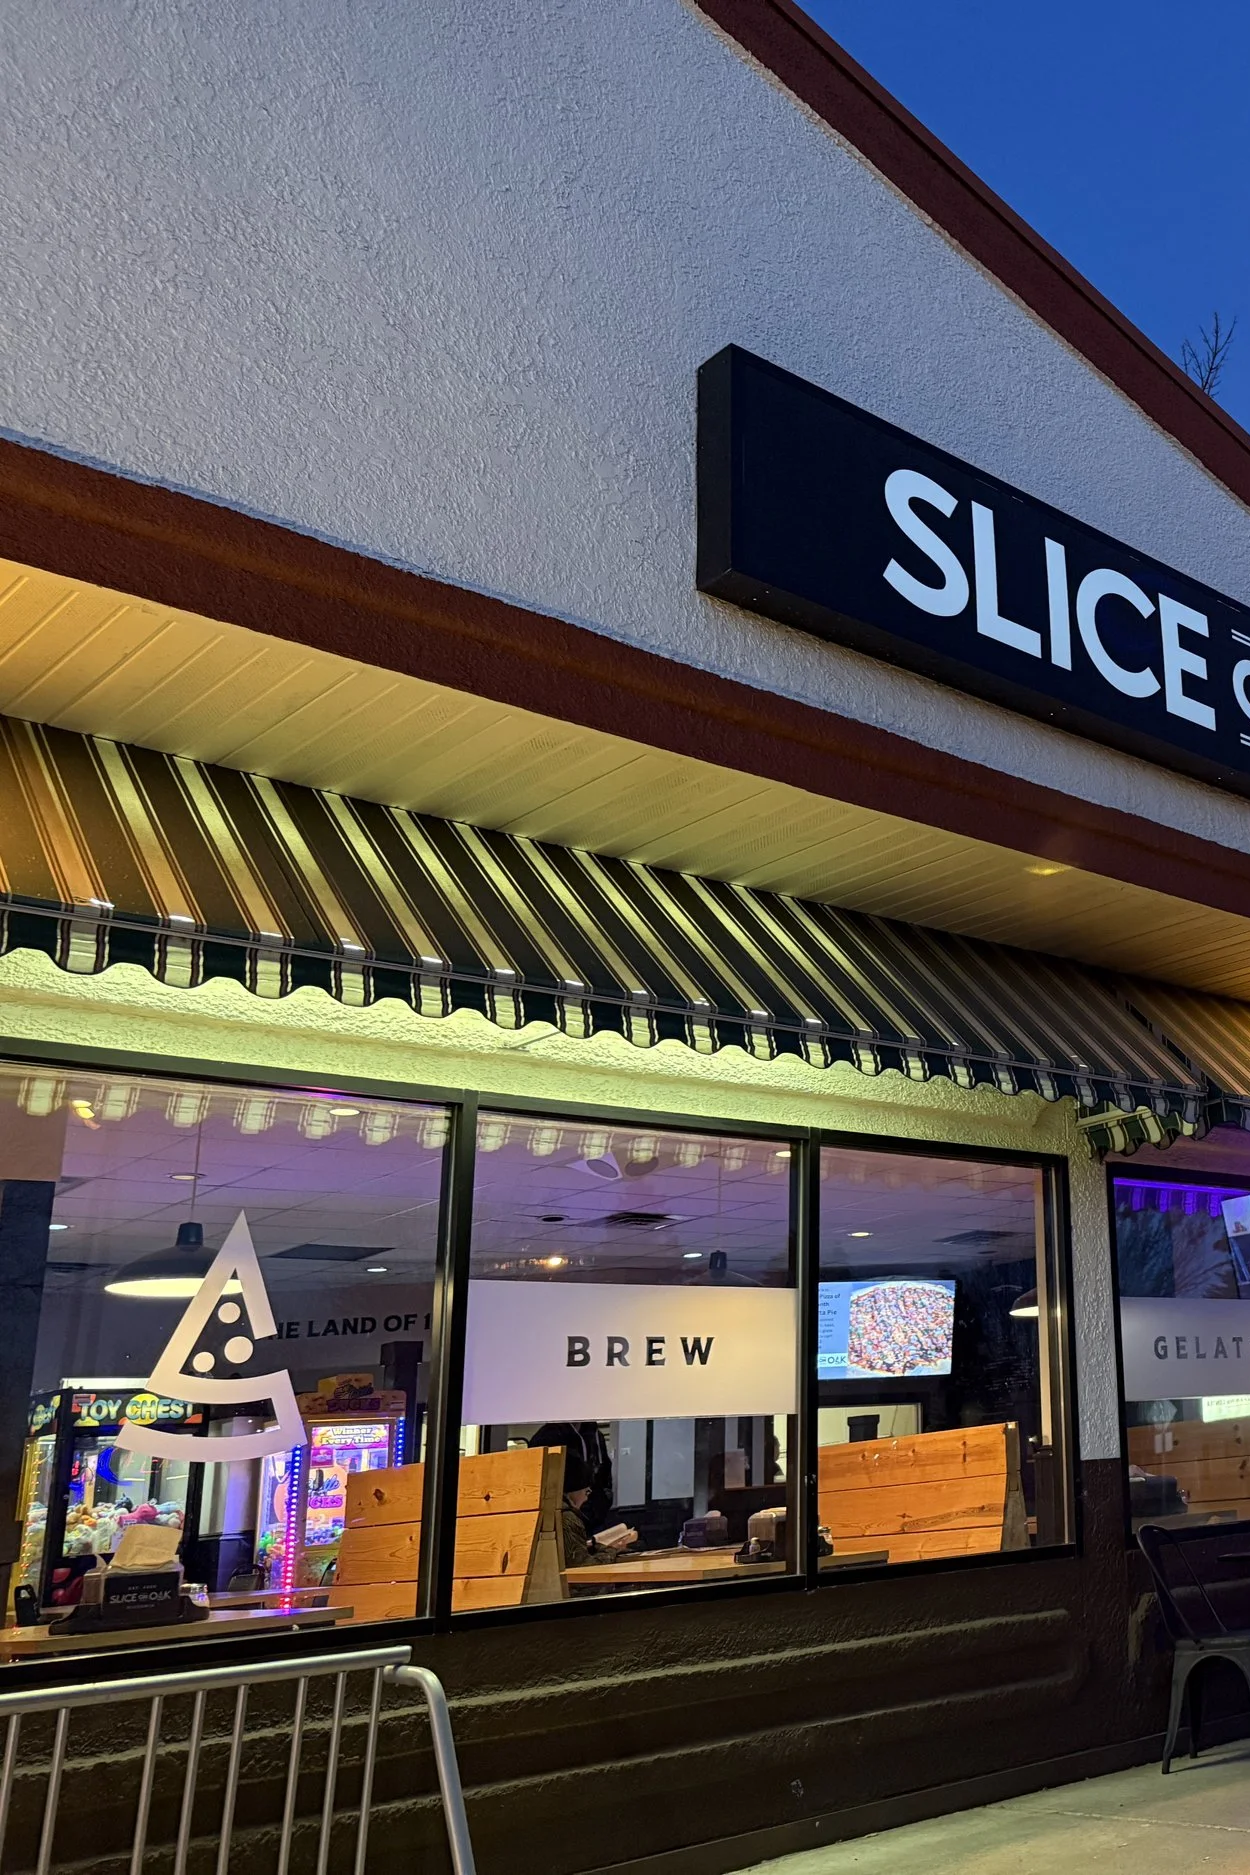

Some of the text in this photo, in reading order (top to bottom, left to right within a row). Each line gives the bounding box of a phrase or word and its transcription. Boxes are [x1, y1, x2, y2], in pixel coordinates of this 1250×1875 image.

[883, 468, 1217, 732] SLICE
[306, 1316, 377, 1338] LAND
[383, 1313, 418, 1333] OF
[566, 1336, 716, 1367] BREW
[79, 1399, 122, 1420] TOY
[125, 1398, 195, 1420] CHEST
[321, 1434, 381, 1446] Every Time
[333, 1427, 373, 1436] Winner
